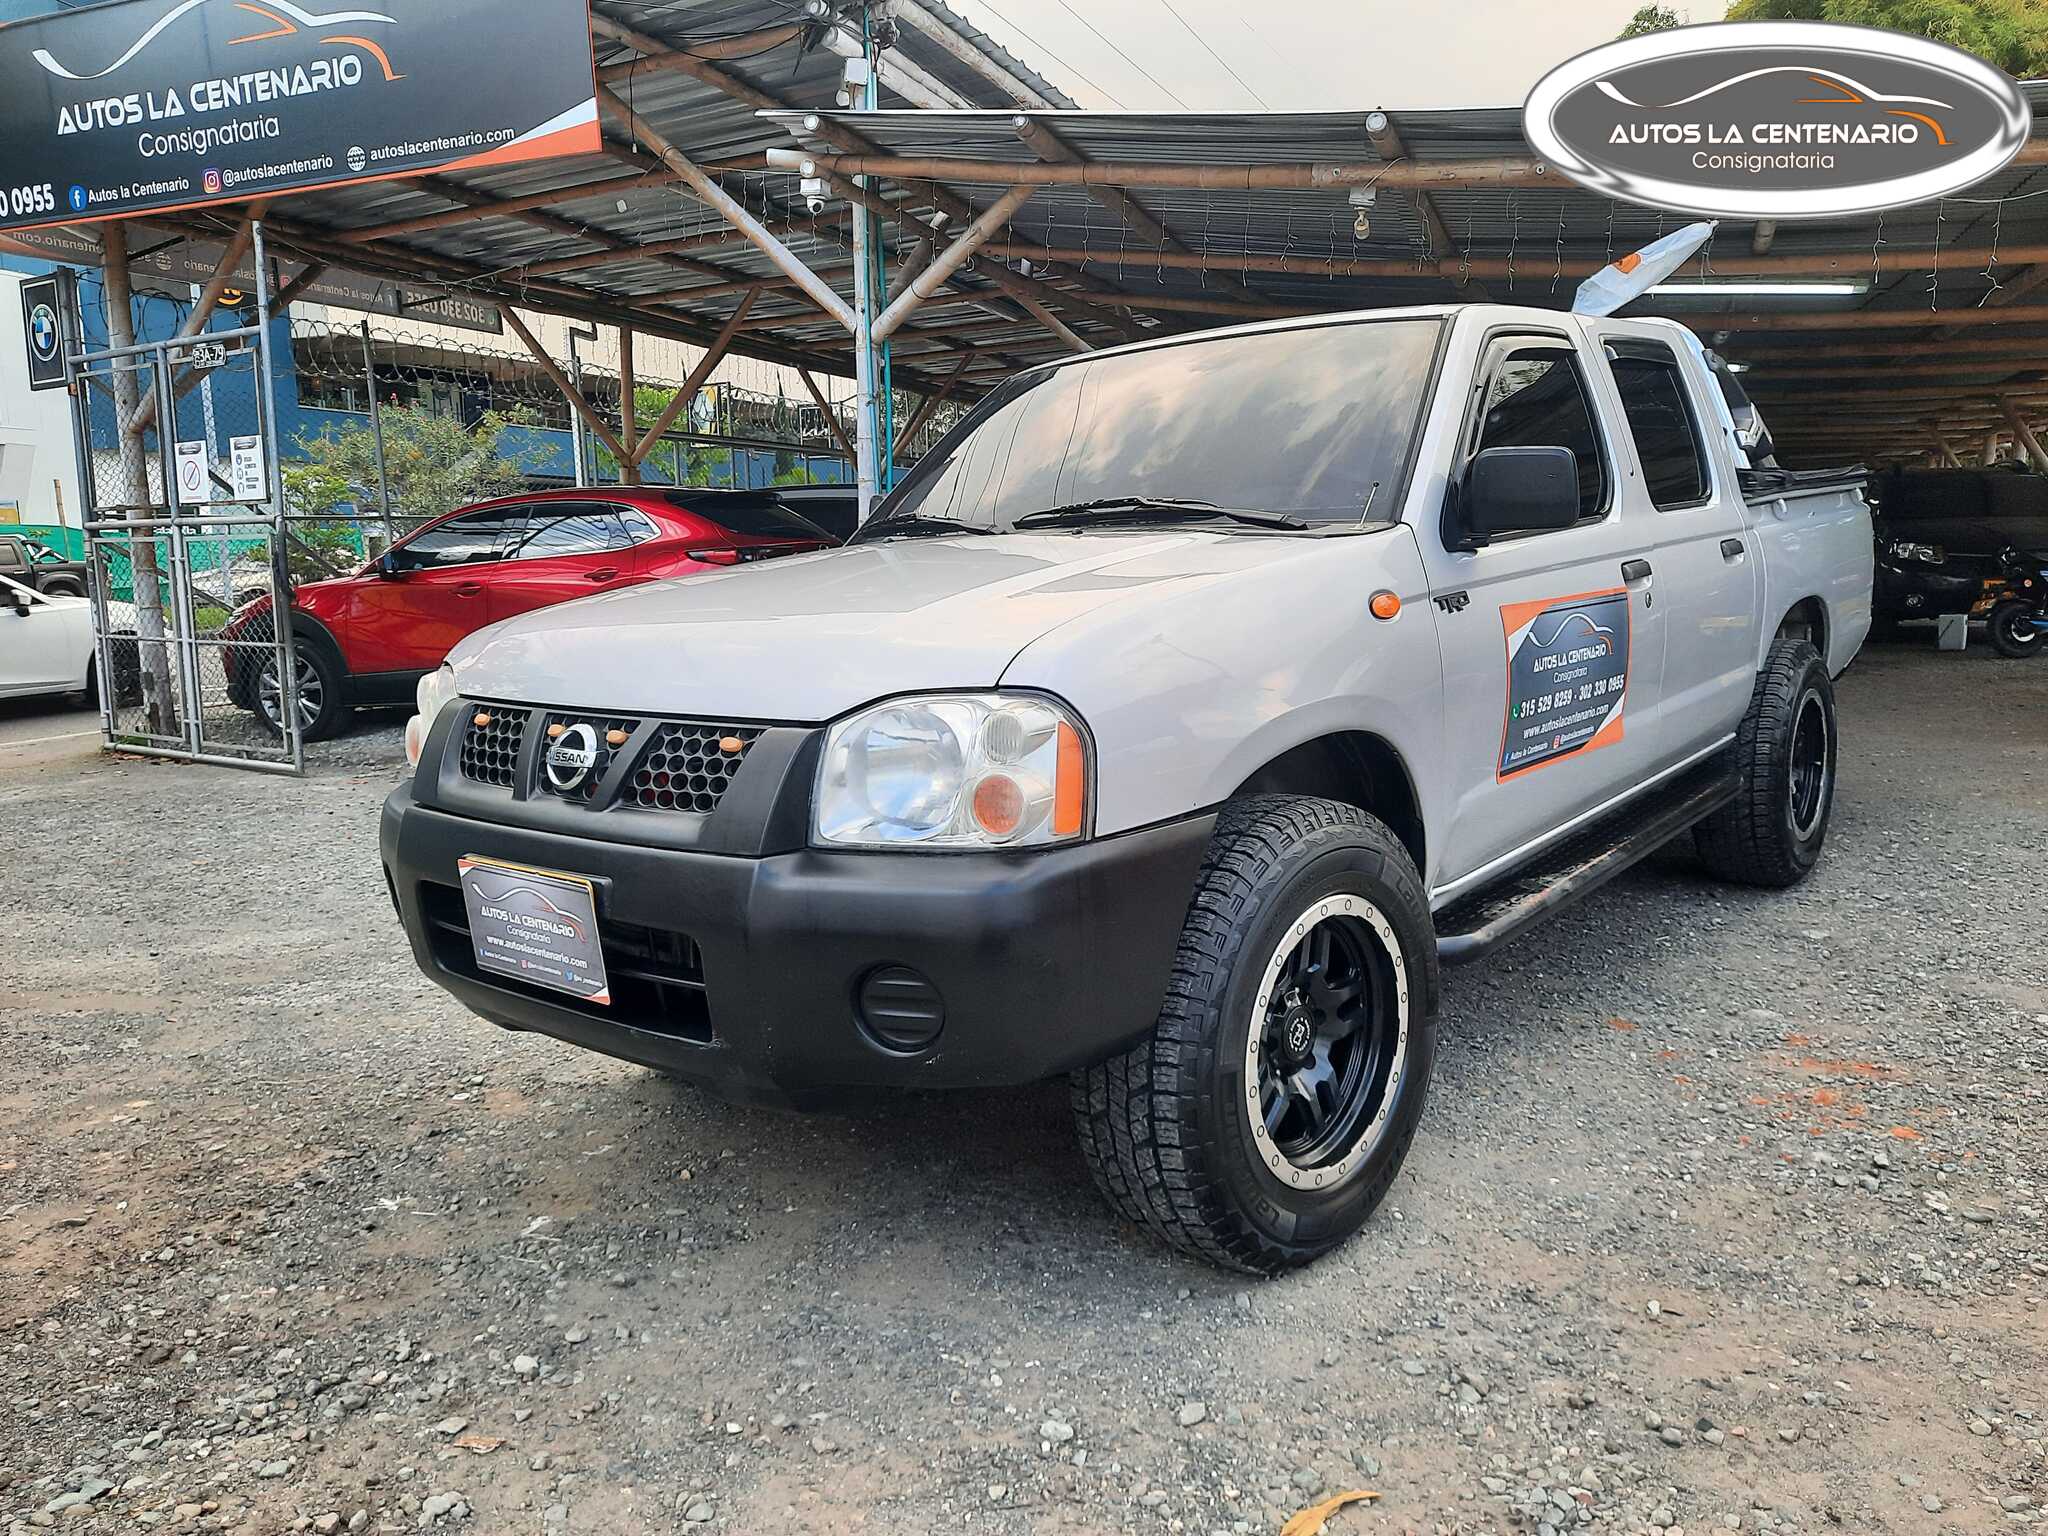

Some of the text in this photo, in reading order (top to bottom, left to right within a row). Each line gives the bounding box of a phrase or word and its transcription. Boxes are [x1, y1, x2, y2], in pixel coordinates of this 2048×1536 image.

[57, 54, 362, 135] AUTOS LA CENTENARIO
[138, 114, 280, 158] Consignataria
[370, 127, 515, 162] autoslacentenario.com
[222, 154, 333, 188] @autoslacentenario
[11, 183, 55, 215] 0955
[88, 176, 190, 204] Autos la Centenario
[1533, 644, 1607, 673] AUTOS LA CENTENARIO
[1520, 699, 1536, 719] 315
[1537, 694, 1552, 713] 529
[1554, 688, 1573, 708] 8259
[1579, 683, 1593, 701] 302
[1523, 704, 1609, 739] www.autoslacentenario.com
[481, 905, 575, 938] AUTOS LA CENTENARIO
